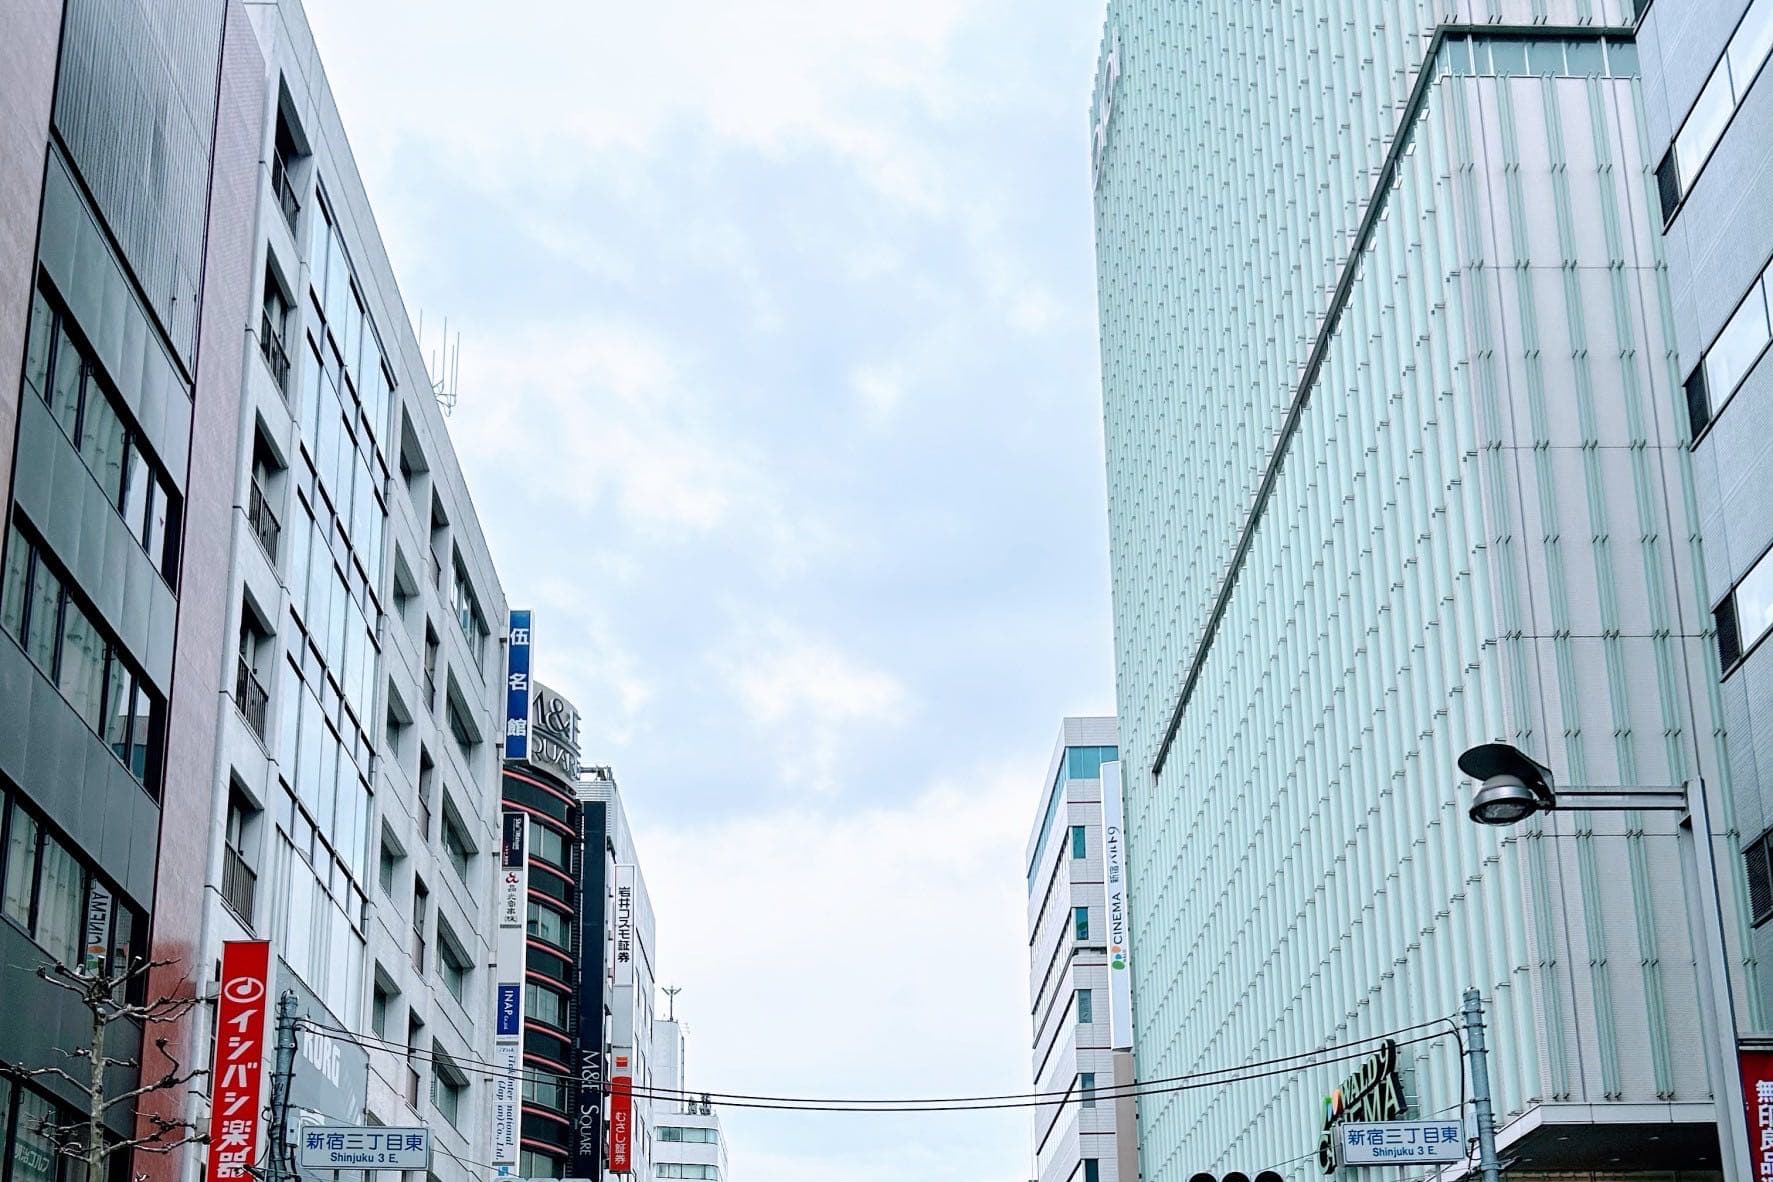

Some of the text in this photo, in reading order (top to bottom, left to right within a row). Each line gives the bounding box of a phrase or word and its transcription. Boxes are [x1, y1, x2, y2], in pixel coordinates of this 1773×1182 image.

[506, 627, 530, 738] 伍名館
[617, 886, 631, 963] 岩井コスモ証券
[1111, 891, 1123, 945] CINEMA
[504, 990, 514, 1016] INAP
[303, 1023, 341, 1088] KORG
[216, 1009, 258, 1179] イシバシ楽器
[306, 1132, 424, 1151] 新宿三丁目東
[579, 1104, 599, 1156] SQUARE
[614, 1111, 627, 1165] むさし証券
[1347, 1126, 1460, 1146] 新宿三丁目東
[1372, 1146, 1414, 1158] Shinjuku
[1417, 1145, 1424, 1155] 3
[330, 1152, 374, 1164] Shinjuku
[378, 1153, 385, 1163] 3
